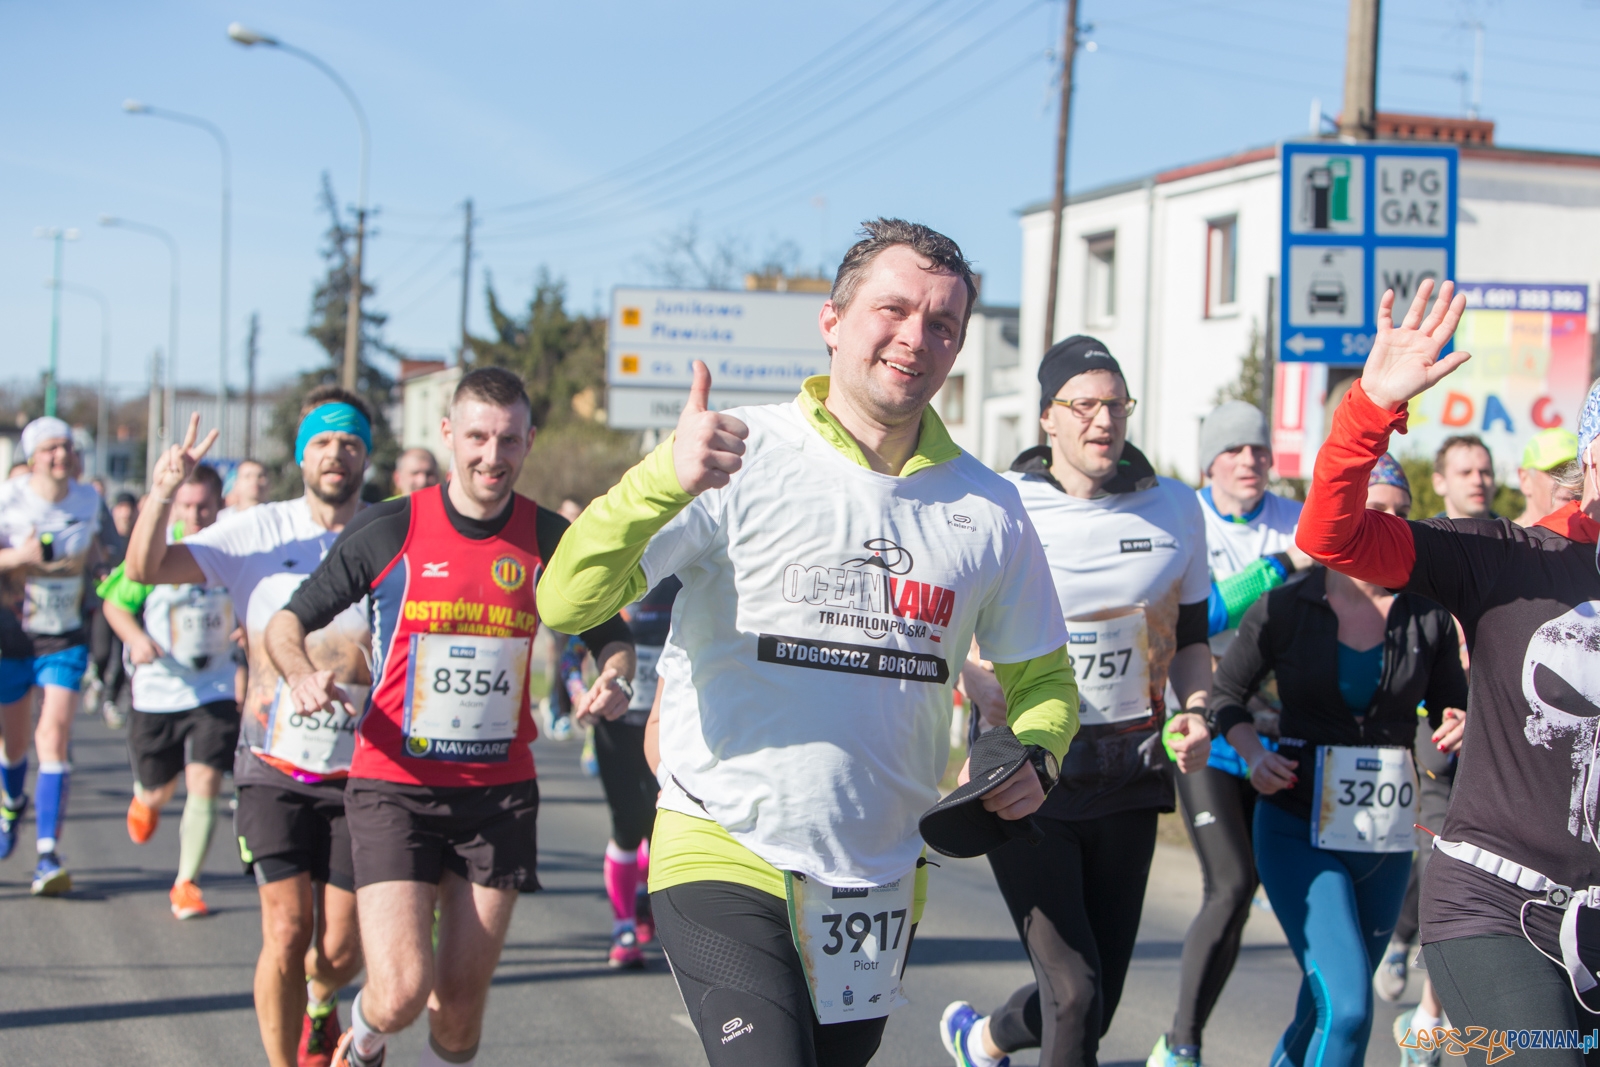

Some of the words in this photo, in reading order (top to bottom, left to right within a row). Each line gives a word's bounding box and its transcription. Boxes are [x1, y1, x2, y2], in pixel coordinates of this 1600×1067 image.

[1381, 168, 1440, 196] LPG
[1381, 199, 1440, 227] GAZ
[404, 597, 484, 621] OSTRÓW
[782, 564, 881, 613] OCEAN
[889, 577, 955, 628] LAVA
[776, 642, 870, 669] BYDGOSZCZ
[878, 655, 938, 677] BORÓWNO
[433, 668, 510, 696] 8354
[459, 700, 484, 708] Adam
[435, 741, 509, 756] NAVIGARE
[1338, 779, 1413, 808] 3200
[822, 909, 907, 956] 3917
[854, 960, 879, 971] Piotr
